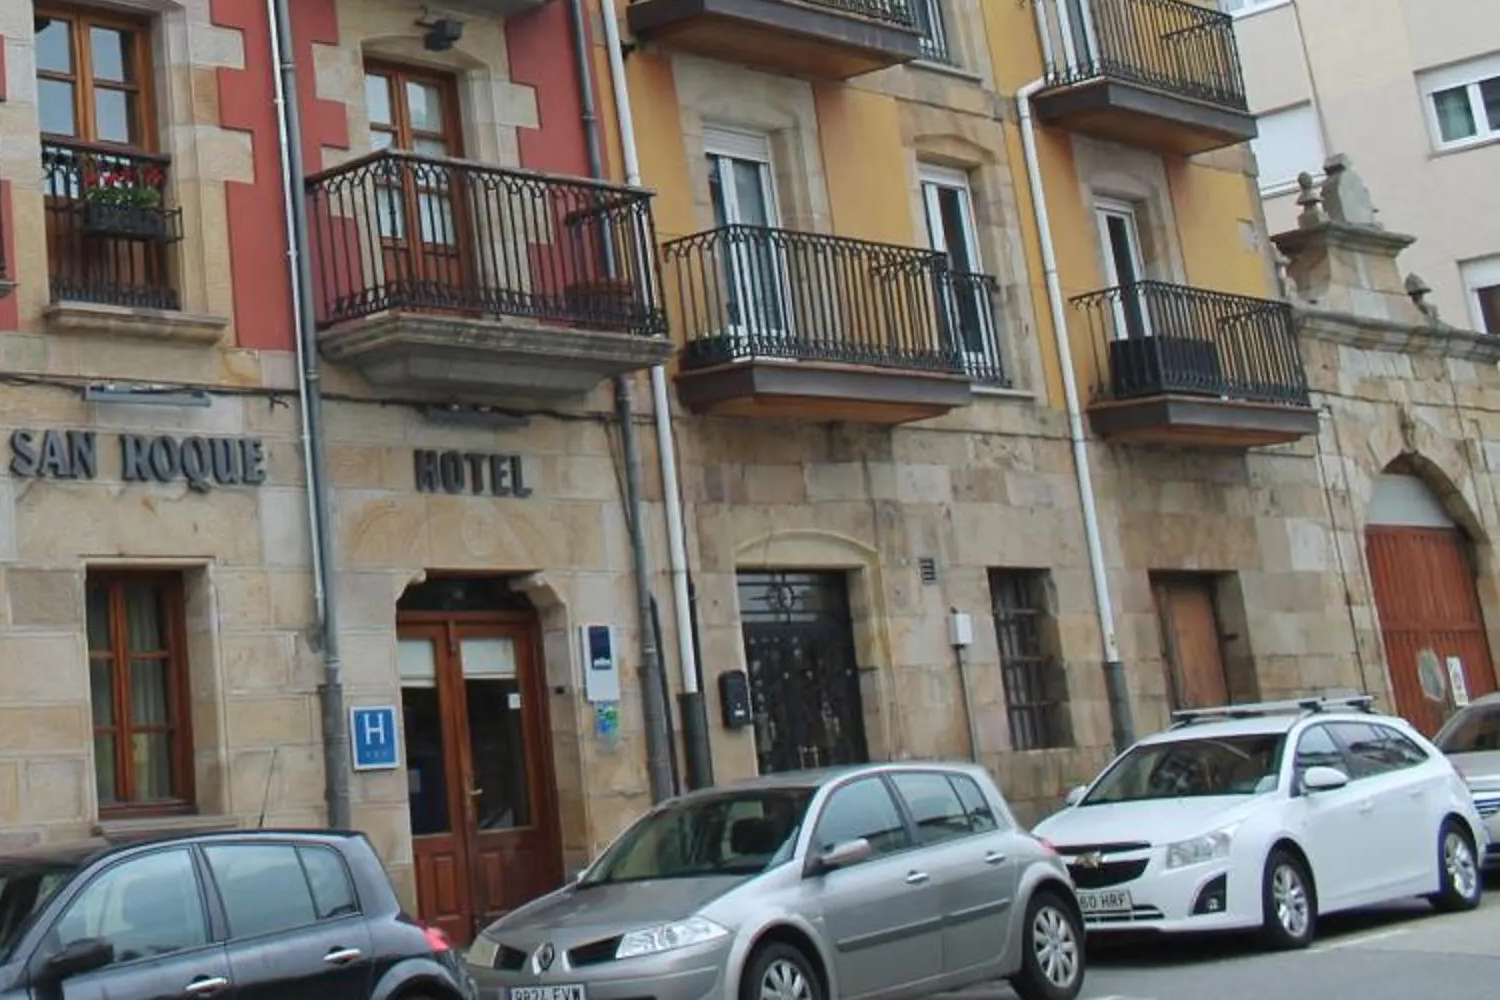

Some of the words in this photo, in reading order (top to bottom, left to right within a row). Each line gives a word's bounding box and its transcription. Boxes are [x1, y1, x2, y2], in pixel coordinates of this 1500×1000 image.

[9, 429, 98, 480] SAN
[119, 433, 267, 493] ROQUE
[412, 448, 533, 498] HOTEL
[363, 712, 385, 745] H
